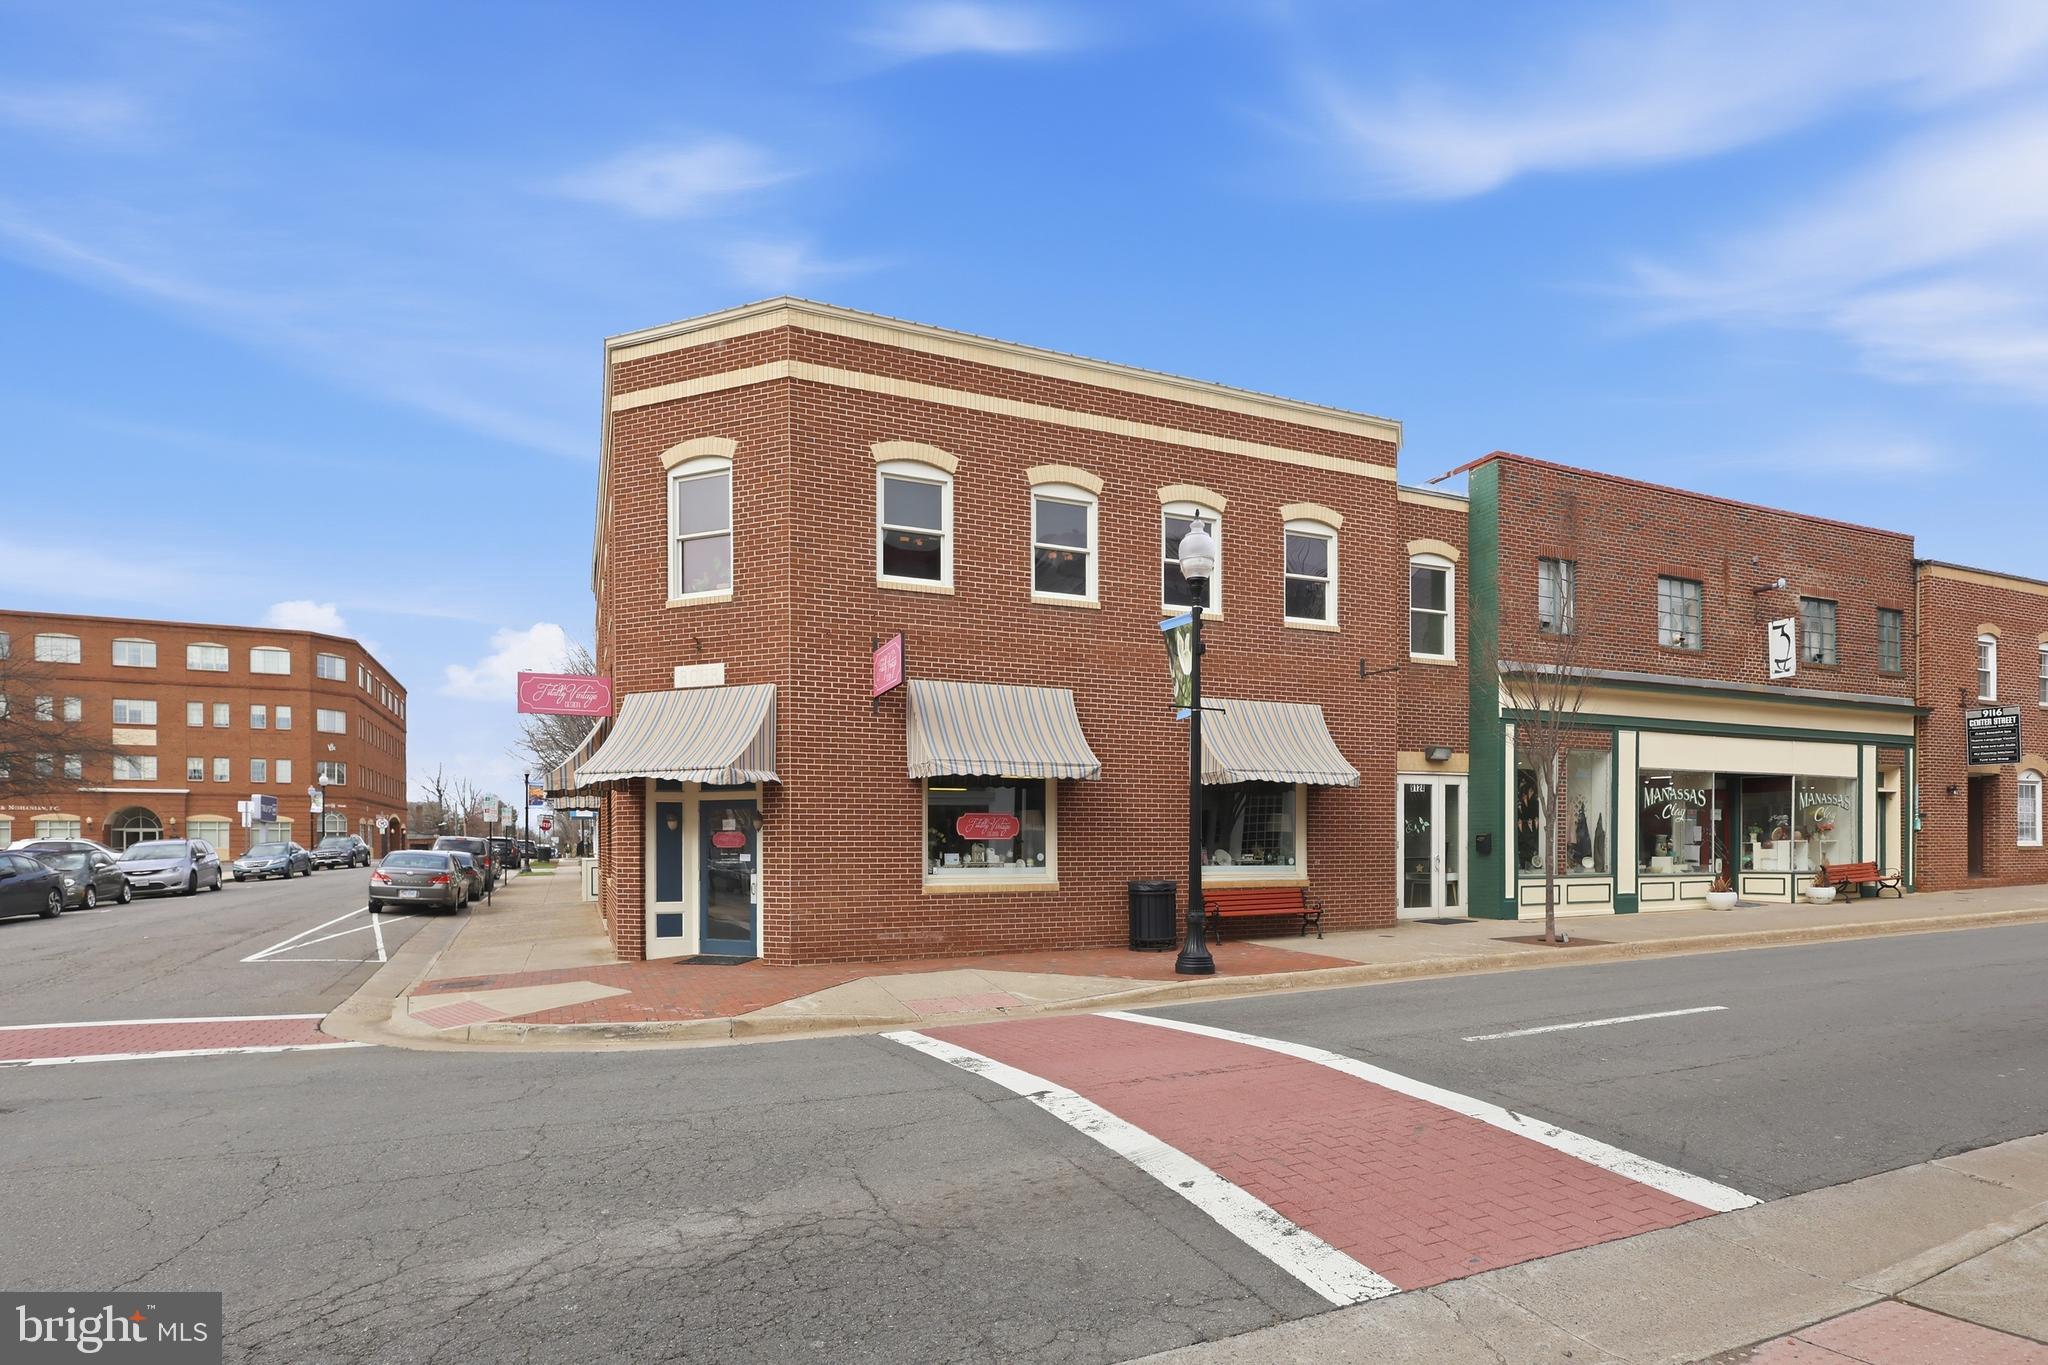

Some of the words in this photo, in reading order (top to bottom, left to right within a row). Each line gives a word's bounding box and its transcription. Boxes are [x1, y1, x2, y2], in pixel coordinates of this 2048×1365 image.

[533, 683, 567, 704] Totally
[567, 684, 598, 708] Vintage
[1969, 718, 1992, 727] CENTER
[1993, 716, 2016, 725] STREET
[1982, 709, 2003, 717] 9116
[1644, 787, 1706, 808] MANASSAS
[1800, 792, 1849, 811] MANASSAS
[1662, 803, 1686, 823] Clay
